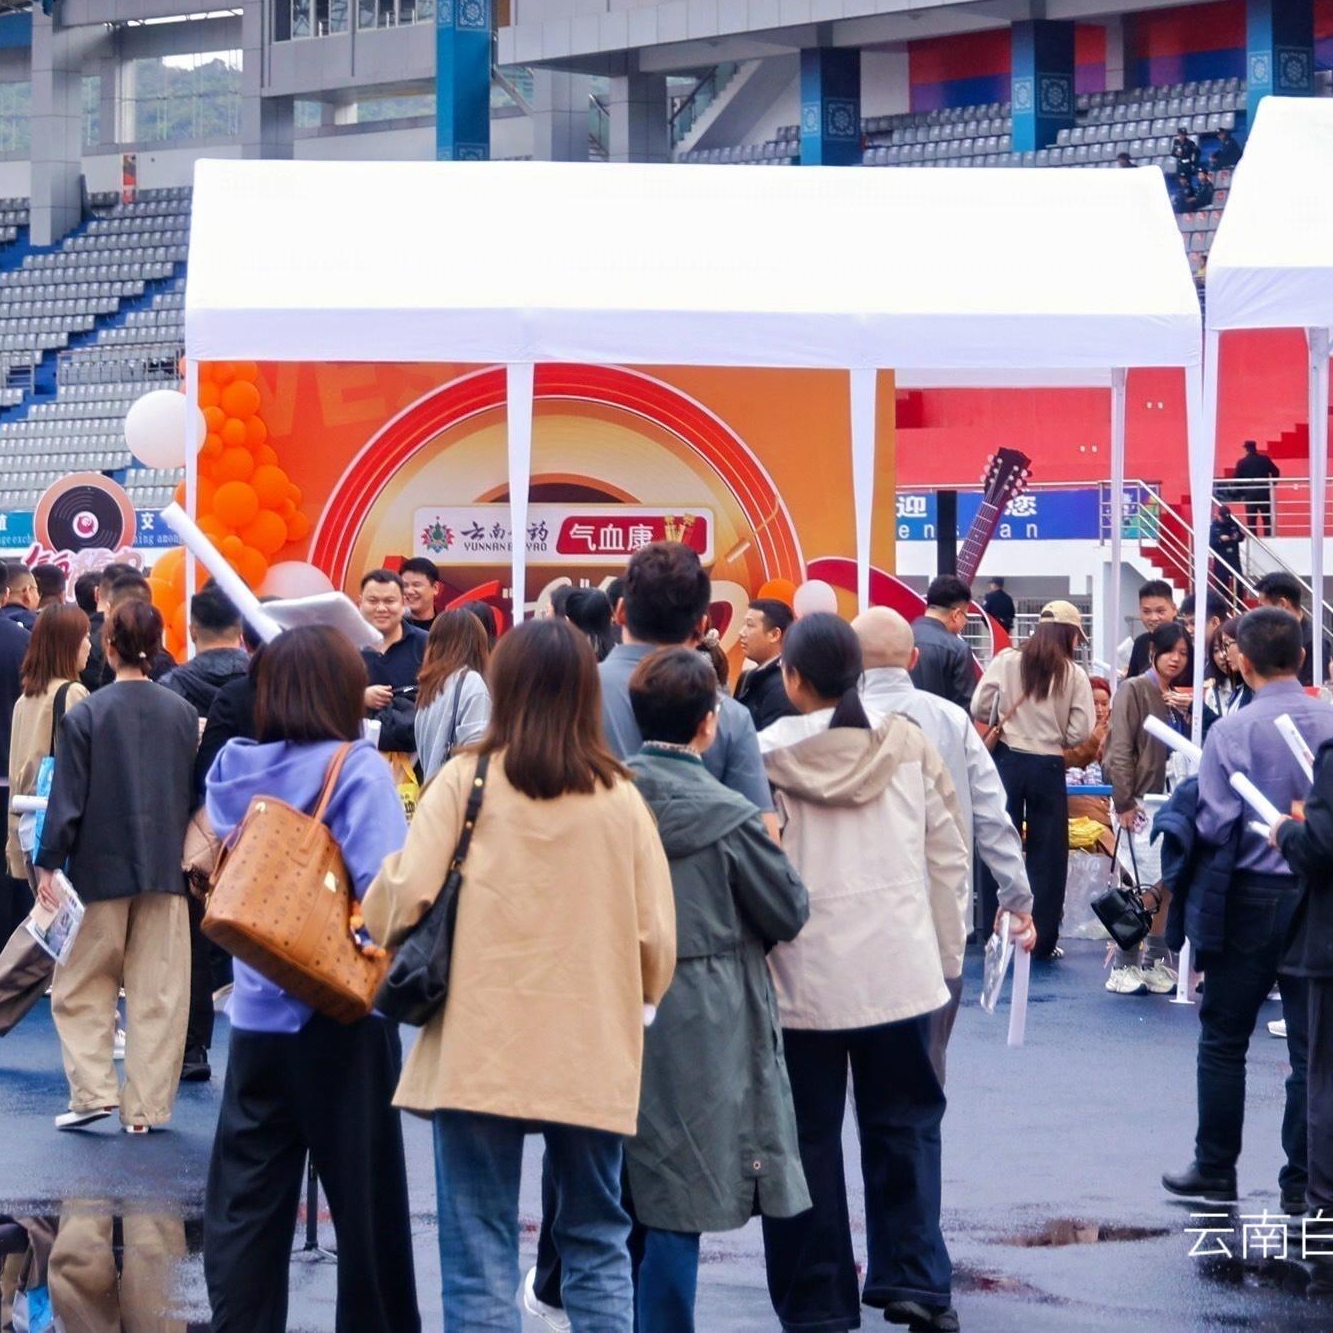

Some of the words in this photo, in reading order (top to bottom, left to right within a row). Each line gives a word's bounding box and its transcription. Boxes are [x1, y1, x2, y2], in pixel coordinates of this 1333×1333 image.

[461, 521, 549, 542] 云南药
[570, 523, 653, 552] 气血康
